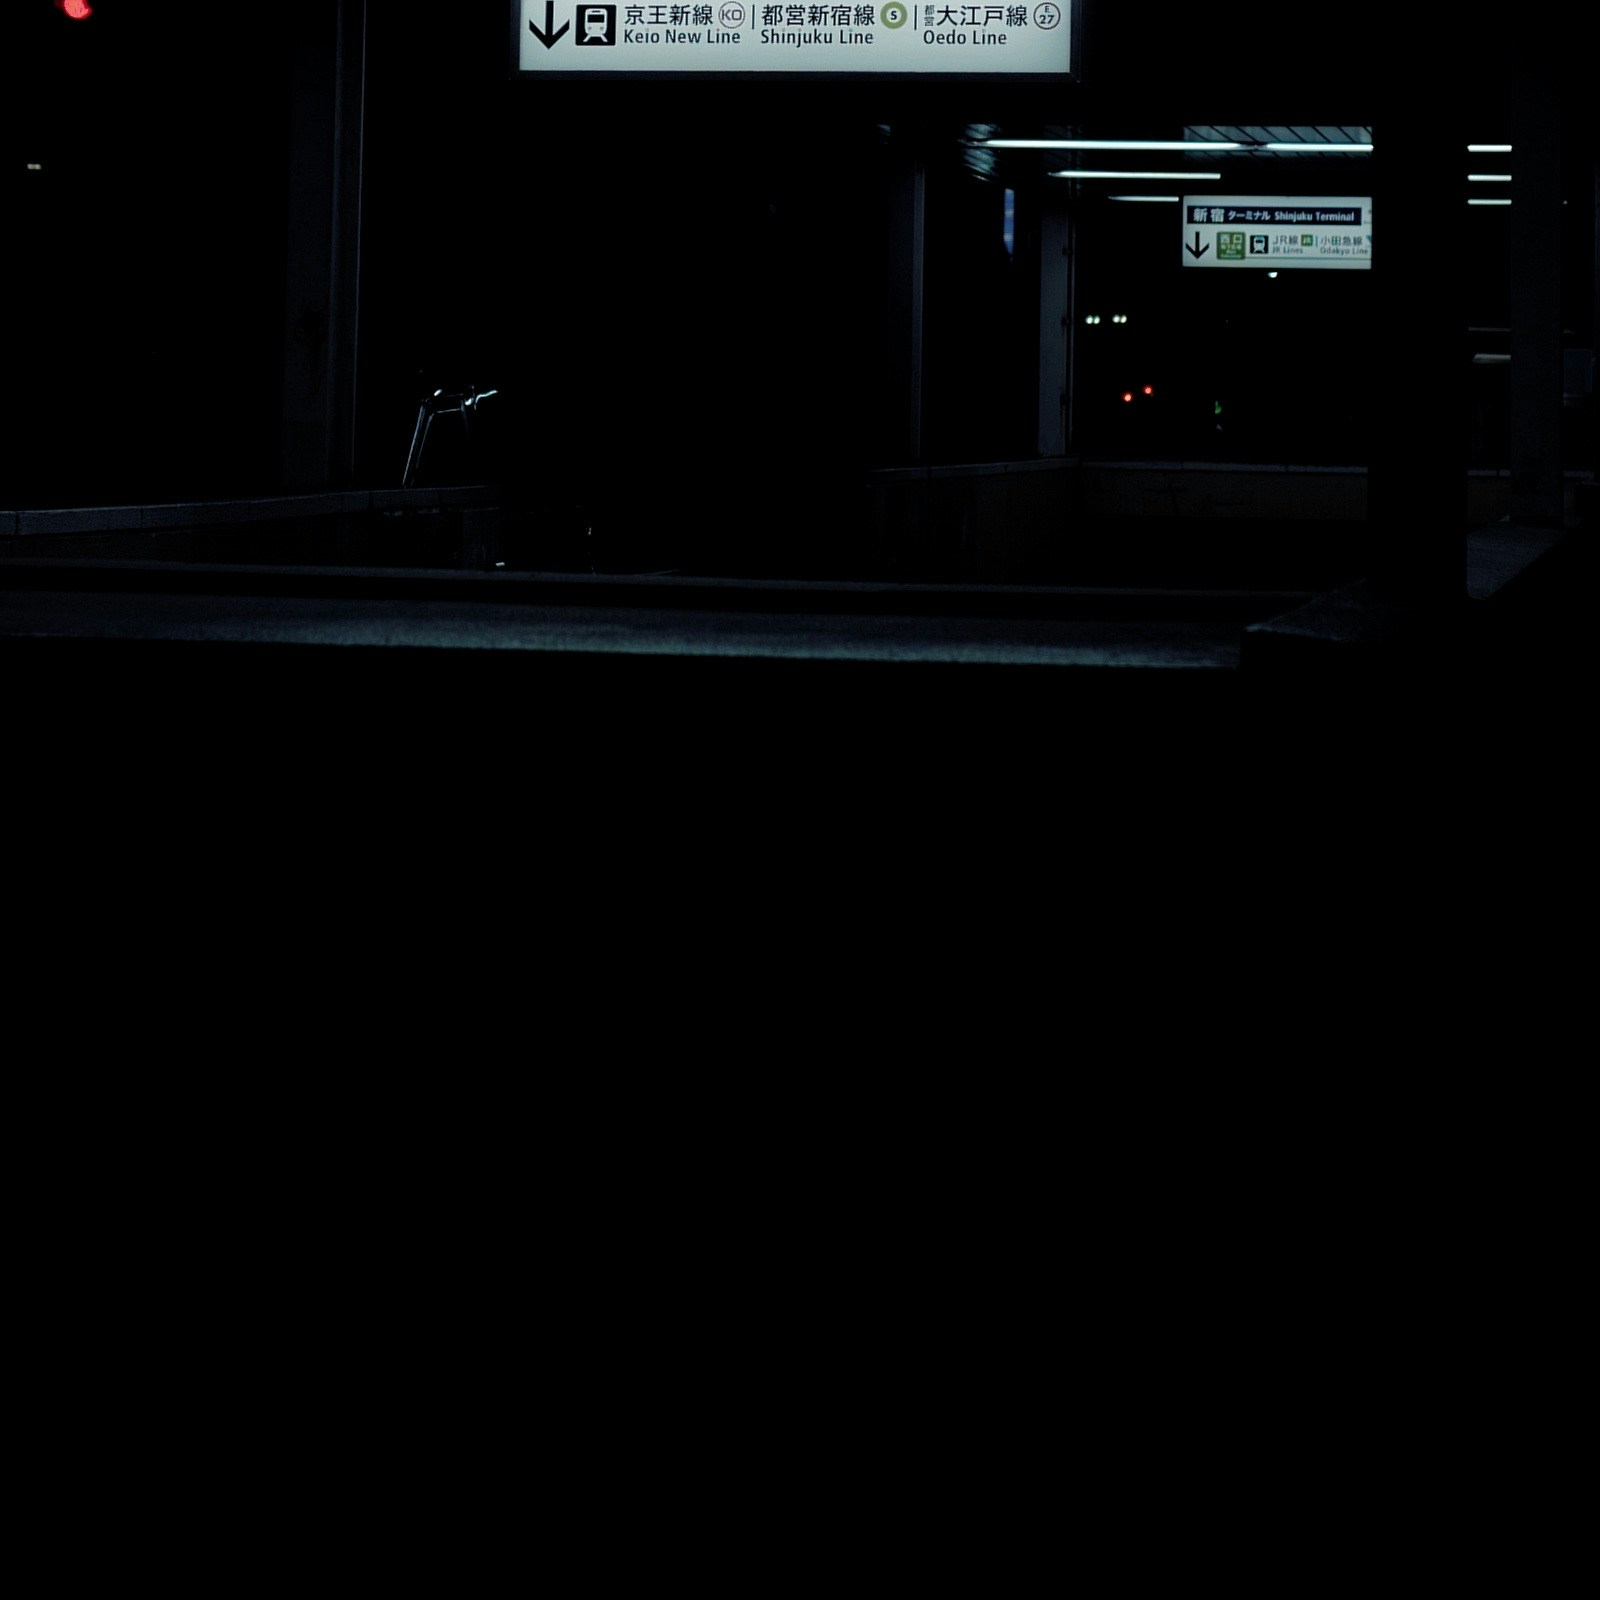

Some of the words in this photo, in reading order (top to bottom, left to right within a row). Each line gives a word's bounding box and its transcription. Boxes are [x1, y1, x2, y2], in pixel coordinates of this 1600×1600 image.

[624, 4, 713, 26] 京王新線
[761, 4, 875, 27] 都営新宿線
[1039, 13, 1054, 25] 27
[624, 28, 660, 44] Keio
[666, 29, 701, 44] New
[707, 28, 741, 44] Line
[761, 29, 833, 49] Shinjuku
[840, 29, 874, 45] Line
[924, 29, 967, 45] Oedo
[973, 29, 1007, 45] Line
[1274, 211, 1313, 223] Shinjuku
[1315, 212, 1355, 222] Terminal
[1352, 247, 1369, 256] Line
